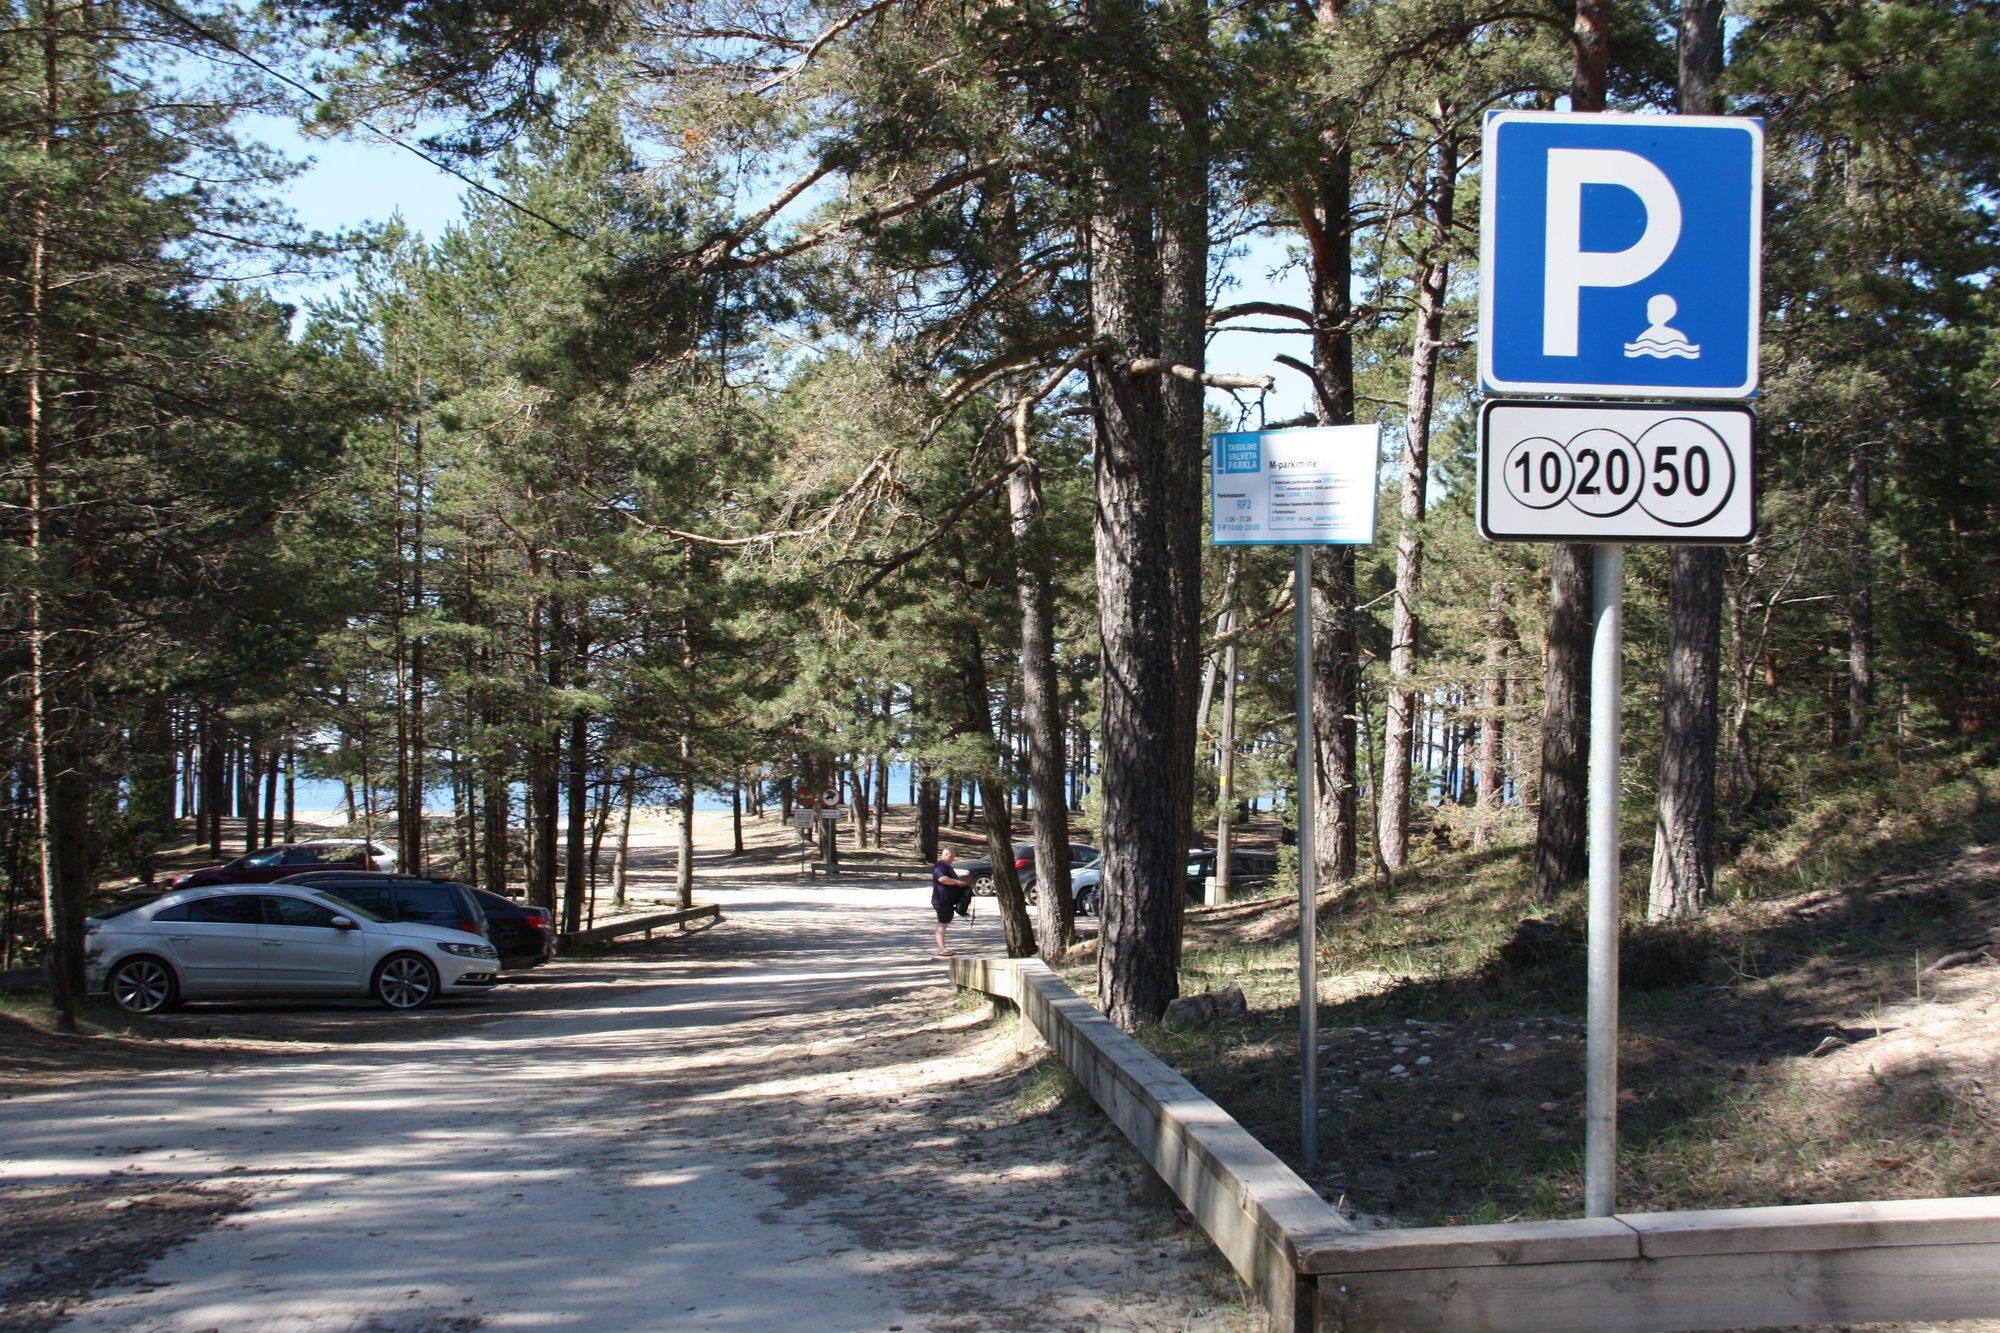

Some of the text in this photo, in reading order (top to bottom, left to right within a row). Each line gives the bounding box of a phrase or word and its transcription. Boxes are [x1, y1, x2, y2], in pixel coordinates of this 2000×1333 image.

[1543, 148, 1682, 357] P
[1227, 443, 1257, 451] TASULINE
[1228, 452, 1257, 460] VALVETA
[1228, 461, 1257, 469] PARKLA
[1269, 460, 1318, 470] M-parkimine
[1514, 446, 1710, 498] 10 20 50
[1237, 499, 1251, 509] RP2
